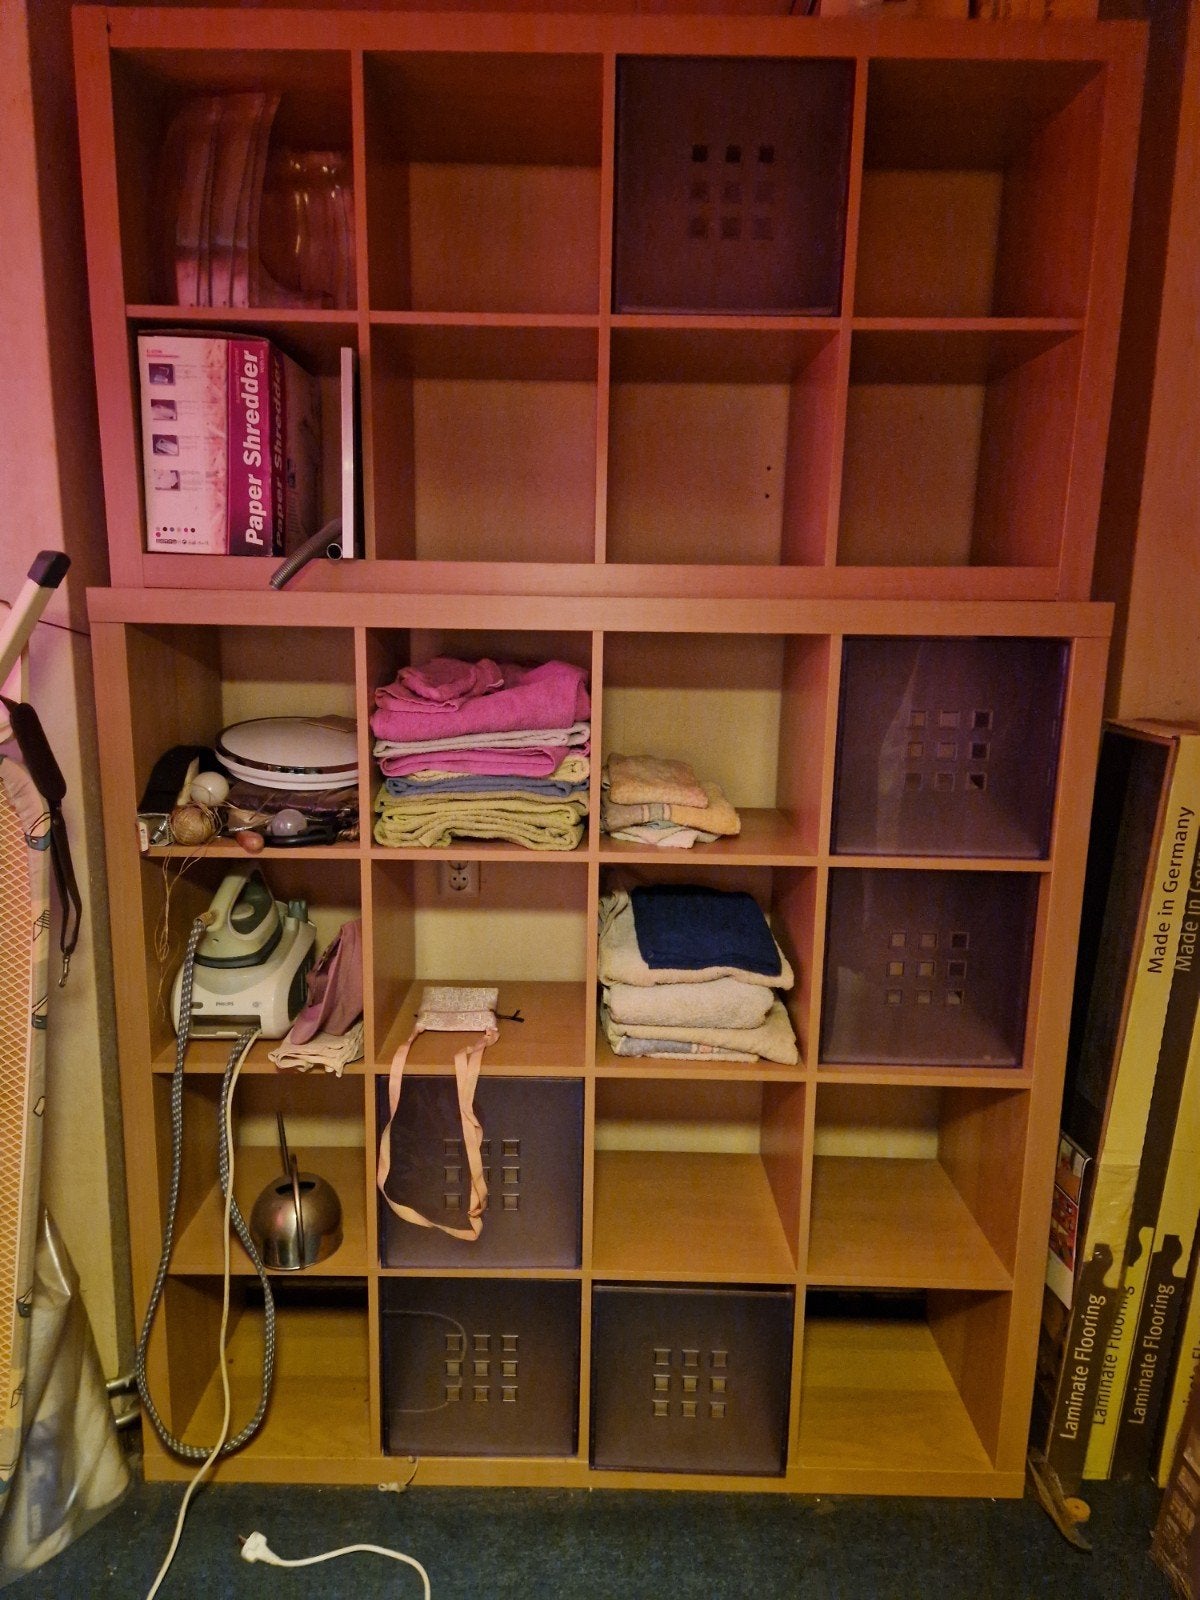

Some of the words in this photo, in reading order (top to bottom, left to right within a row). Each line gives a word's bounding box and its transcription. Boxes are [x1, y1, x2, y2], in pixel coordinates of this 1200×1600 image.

[240, 350, 262, 467] Shredder
[273, 354, 283, 471] Shredder
[245, 474, 267, 546] Paper
[275, 476, 285, 548] Paper
[1162, 806, 1195, 893] Germany
[1157, 899, 1175, 916] in
[1147, 922, 1171, 974] Made
[1175, 921, 1198, 972] Made
[1142, 1283, 1175, 1349] Flooring
[1059, 1366, 1089, 1440] Laminate
[1074, 1293, 1107, 1361] Flooring
[1128, 1353, 1158, 1424] Laminate
